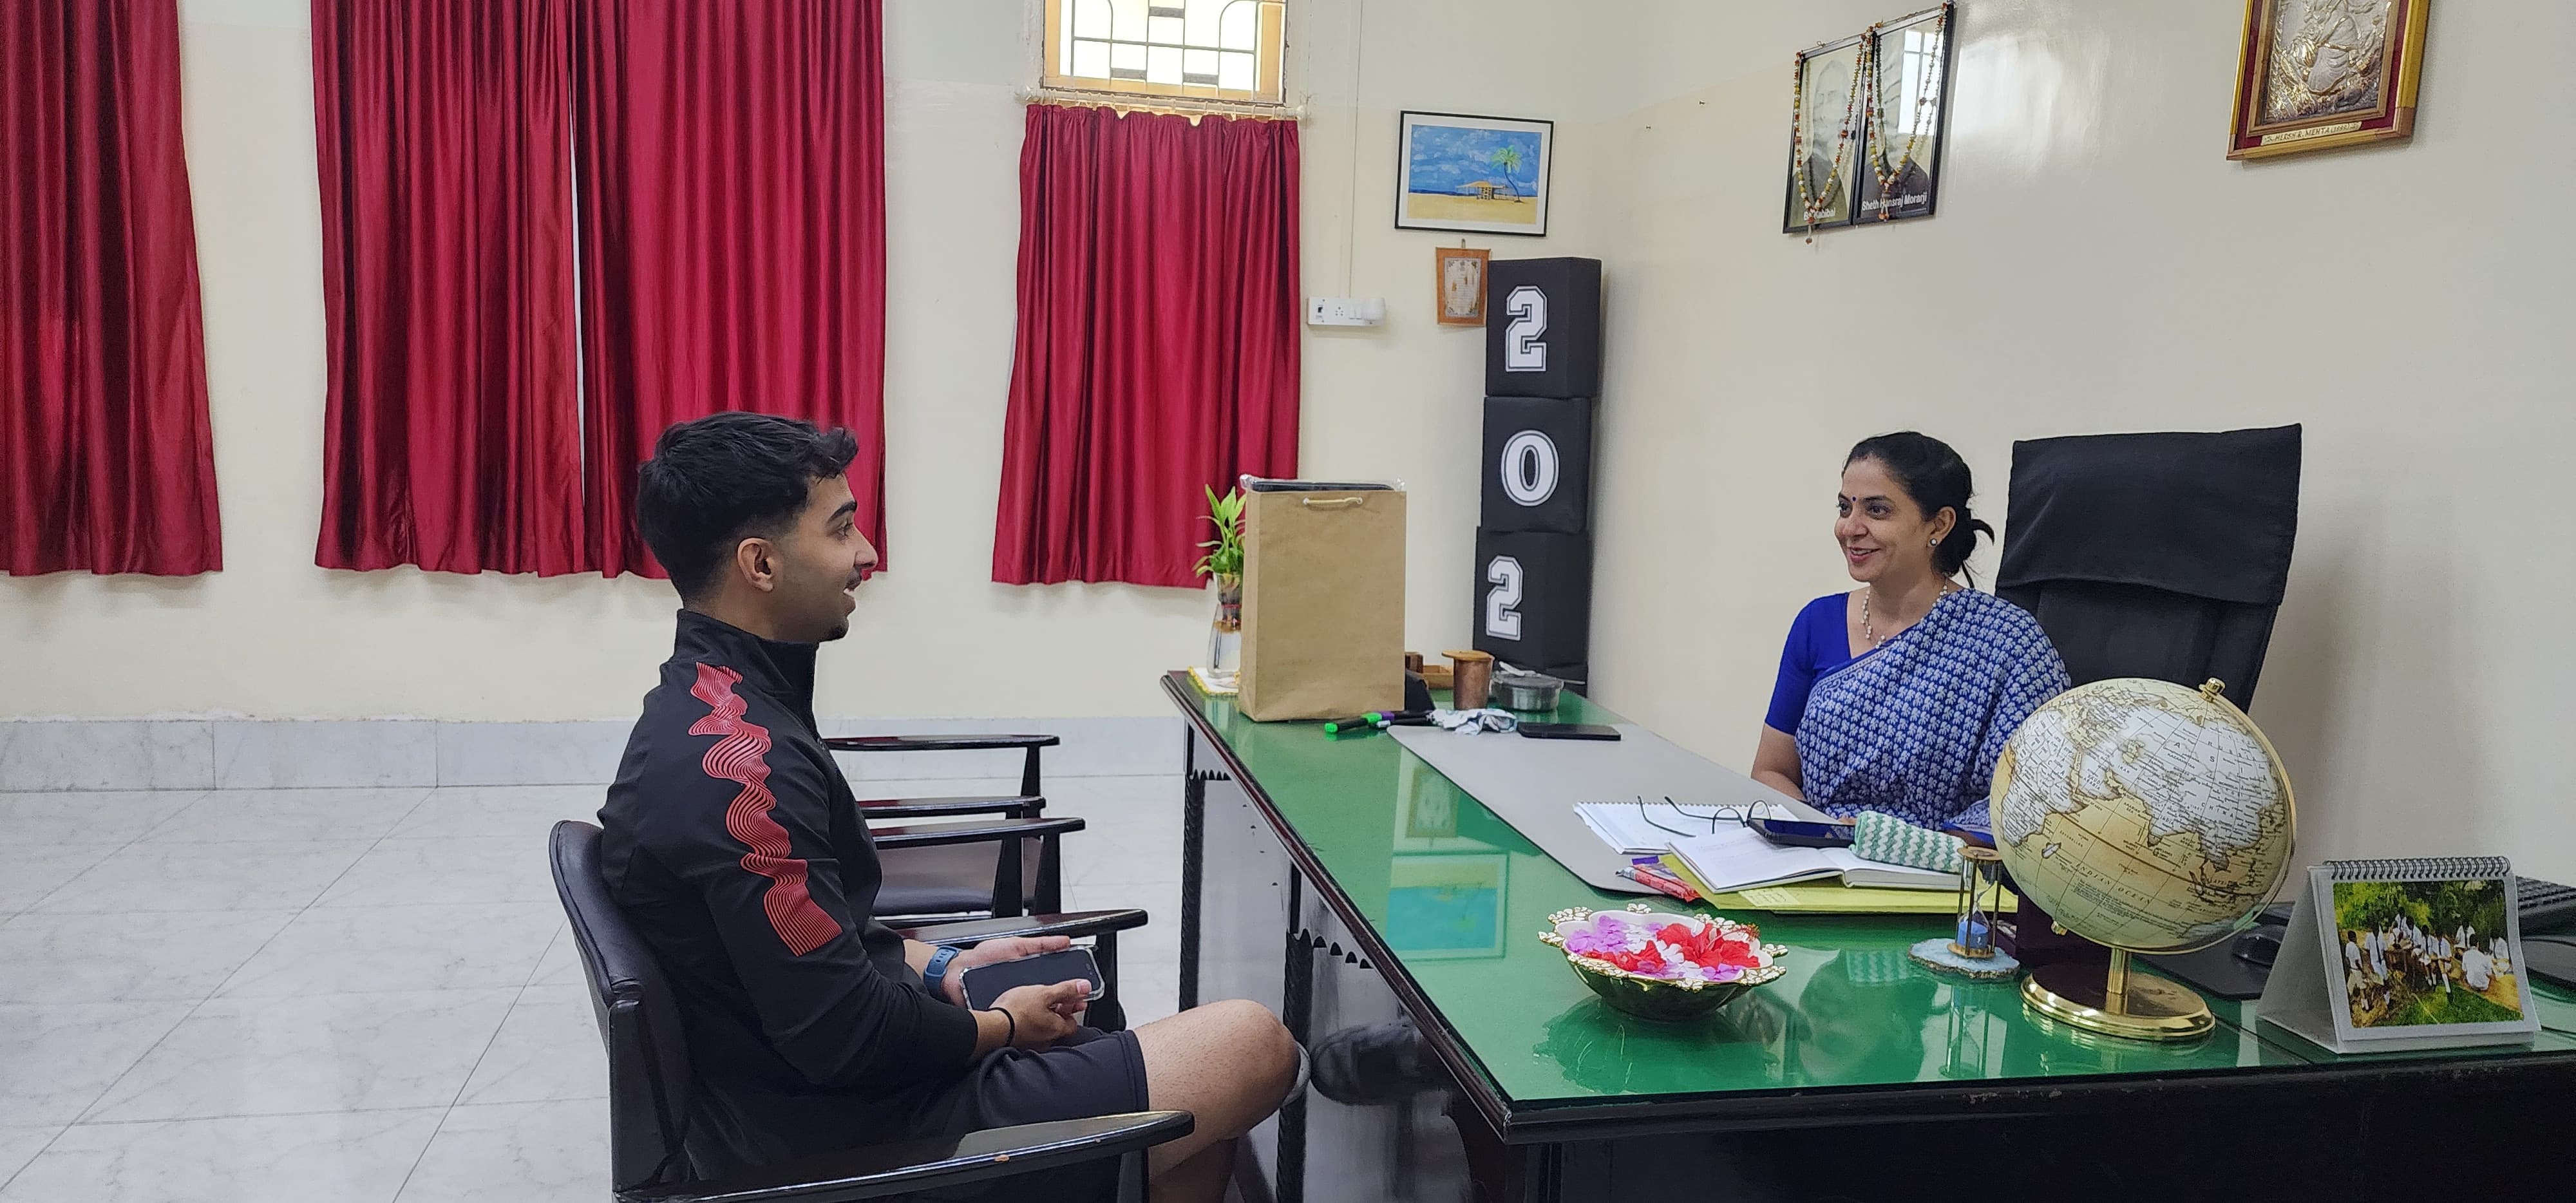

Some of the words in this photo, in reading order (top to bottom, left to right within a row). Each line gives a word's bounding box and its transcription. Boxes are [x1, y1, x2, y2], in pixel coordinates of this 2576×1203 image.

[2305, 127, 2329, 137] MEHTA
[1862, 198, 1879, 211] Sheth
[1904, 191, 1927, 205] Morarji
[1506, 286, 1547, 372] 2
[1501, 430, 1559, 507] 0
[1486, 555, 1523, 641] 2
[2117, 764, 2130, 773] IRAN
[2160, 815, 2174, 825] INDIA
[2201, 802, 2234, 819] CHINA
[2076, 863, 2112, 886] INDIAN
[2117, 886, 2152, 905] OCEAN
